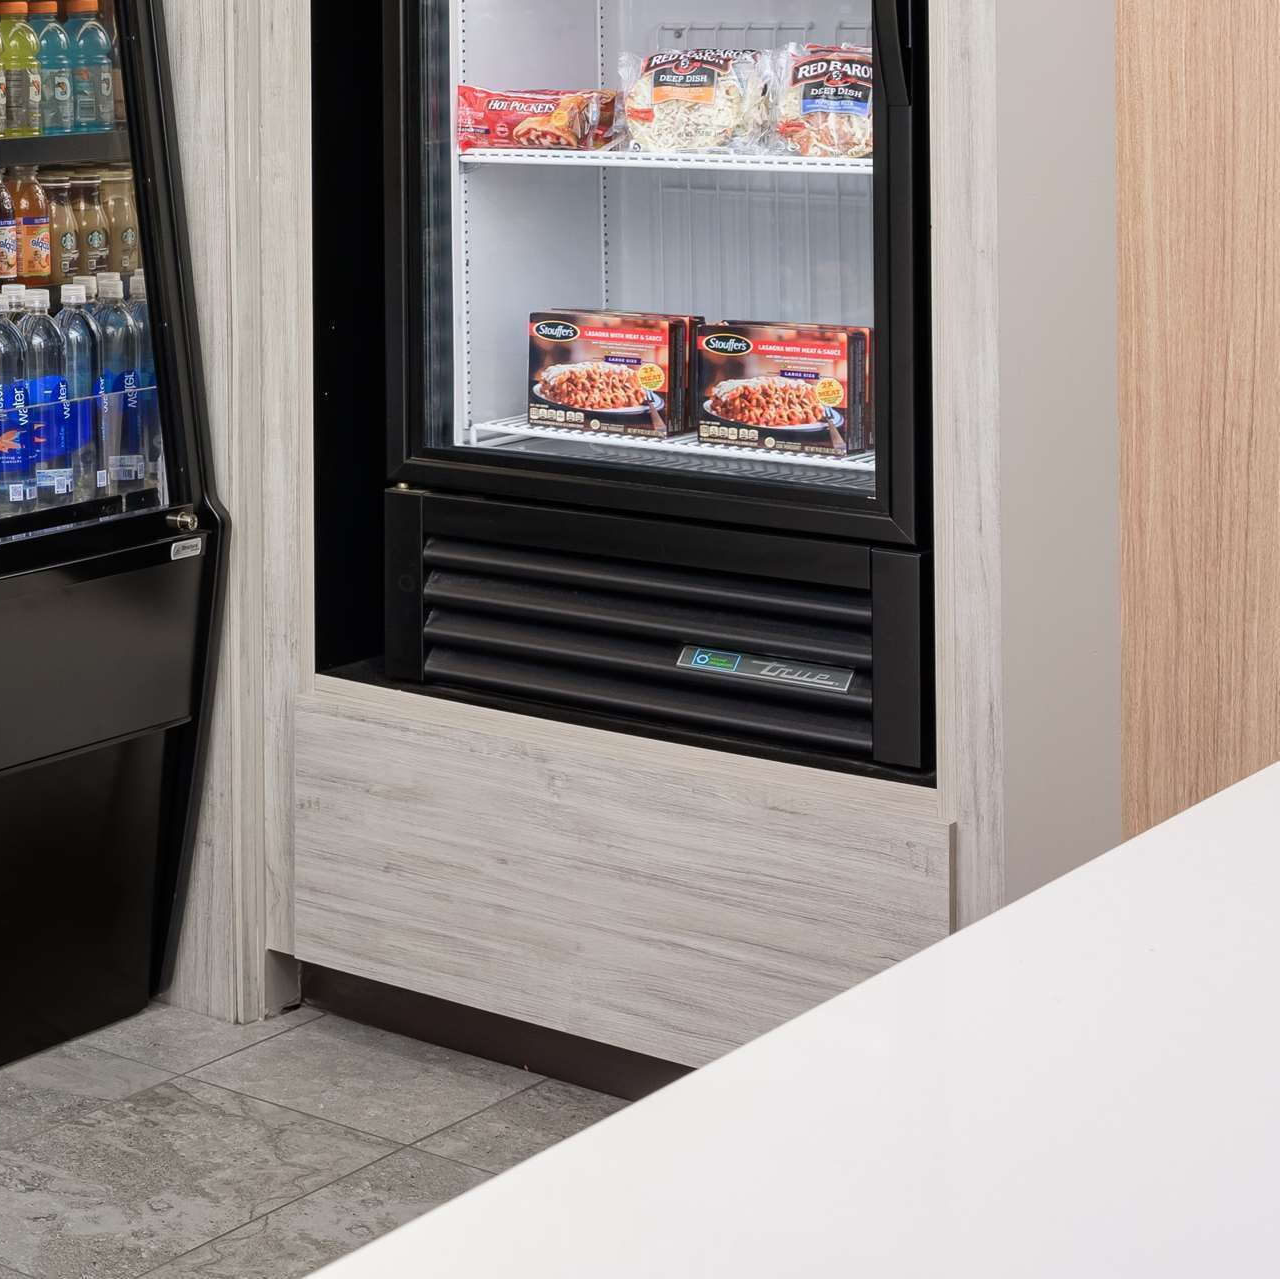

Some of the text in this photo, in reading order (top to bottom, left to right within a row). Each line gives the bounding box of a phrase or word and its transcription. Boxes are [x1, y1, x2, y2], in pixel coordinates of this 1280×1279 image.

[797, 61, 827, 79] RED
[659, 74, 707, 83] DEEP DISH
[810, 87, 862, 98] DEEP DISH
[488, 100, 557, 113] HOT POCKETS
[539, 325, 575, 338] Stouffer's
[708, 337, 747, 352] Stouffer's
